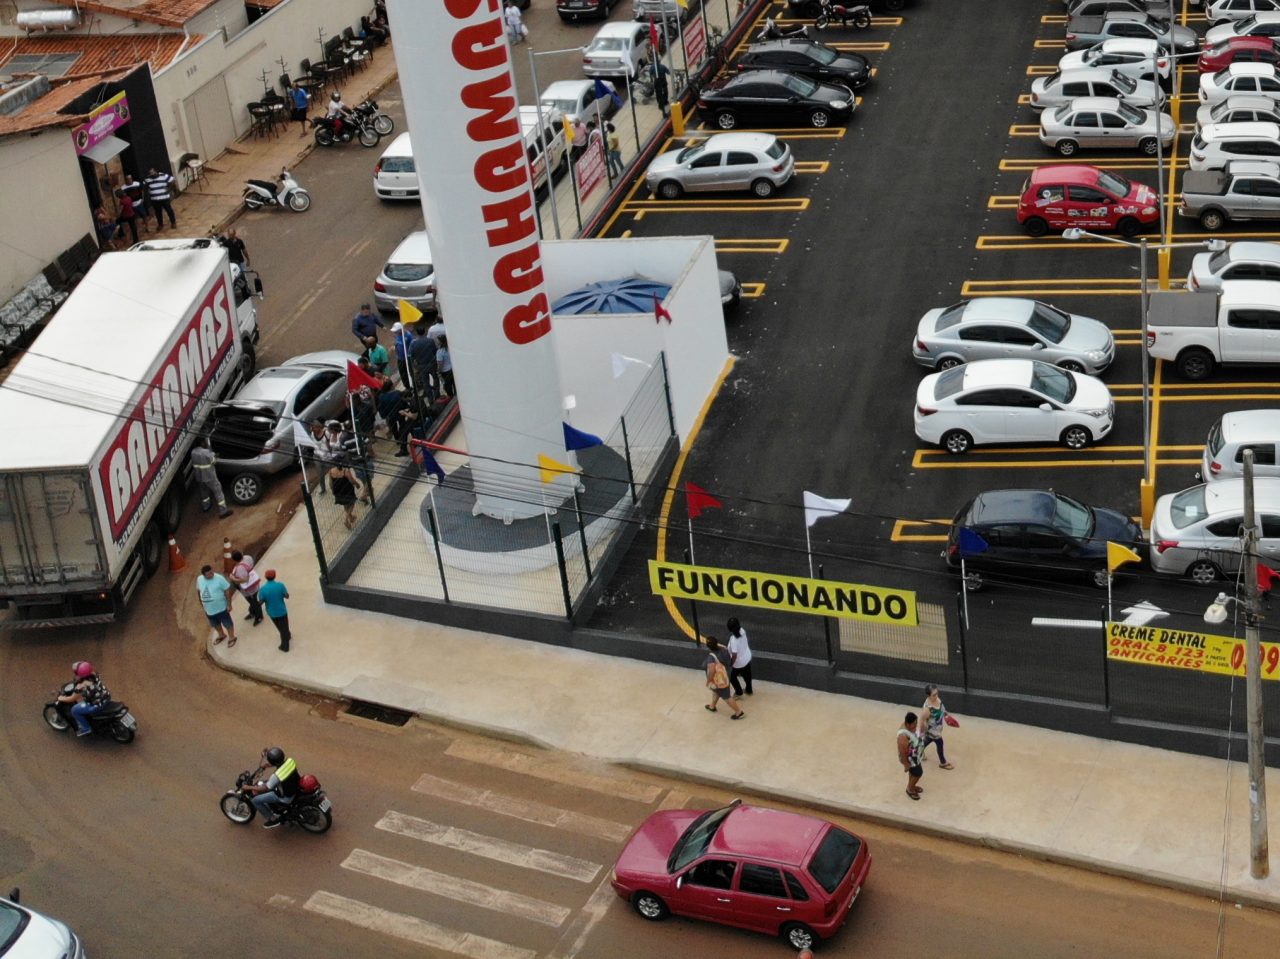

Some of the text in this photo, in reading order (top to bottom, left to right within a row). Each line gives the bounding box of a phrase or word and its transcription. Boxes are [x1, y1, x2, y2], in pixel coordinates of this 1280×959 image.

[109, 284, 229, 524] BAHAMAS
[658, 567, 907, 620] FUNCIONANDO
[1110, 638, 1204, 658] ORAL-B 123
[1111, 624, 1207, 649] CREME DENTAL
